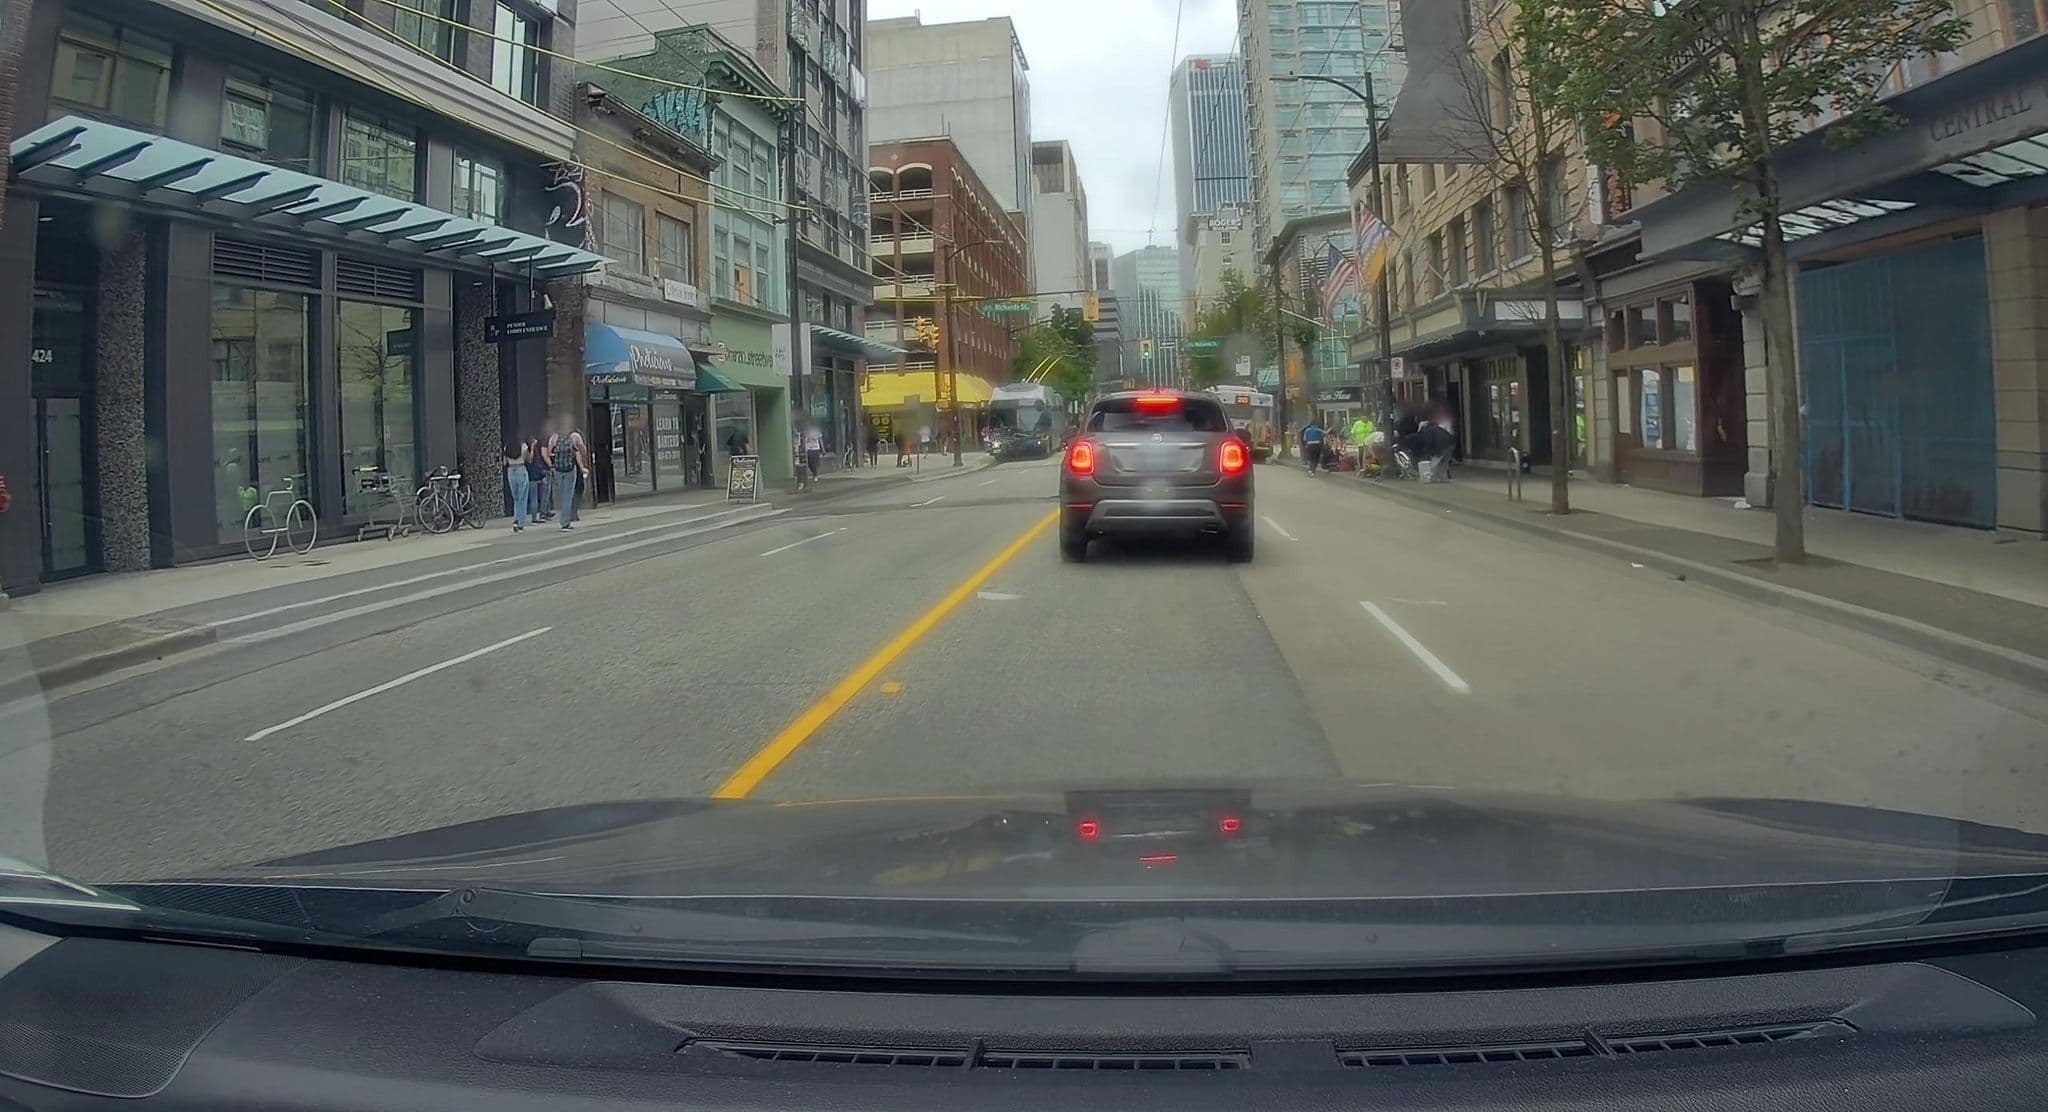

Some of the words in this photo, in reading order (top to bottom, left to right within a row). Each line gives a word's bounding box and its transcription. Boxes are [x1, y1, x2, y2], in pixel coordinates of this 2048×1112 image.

[1929, 88, 2032, 142] CENTRAL
[1209, 219, 1241, 227] ROGERS
[31, 349, 53, 363] 424
[656, 416, 672, 431] LEARN
